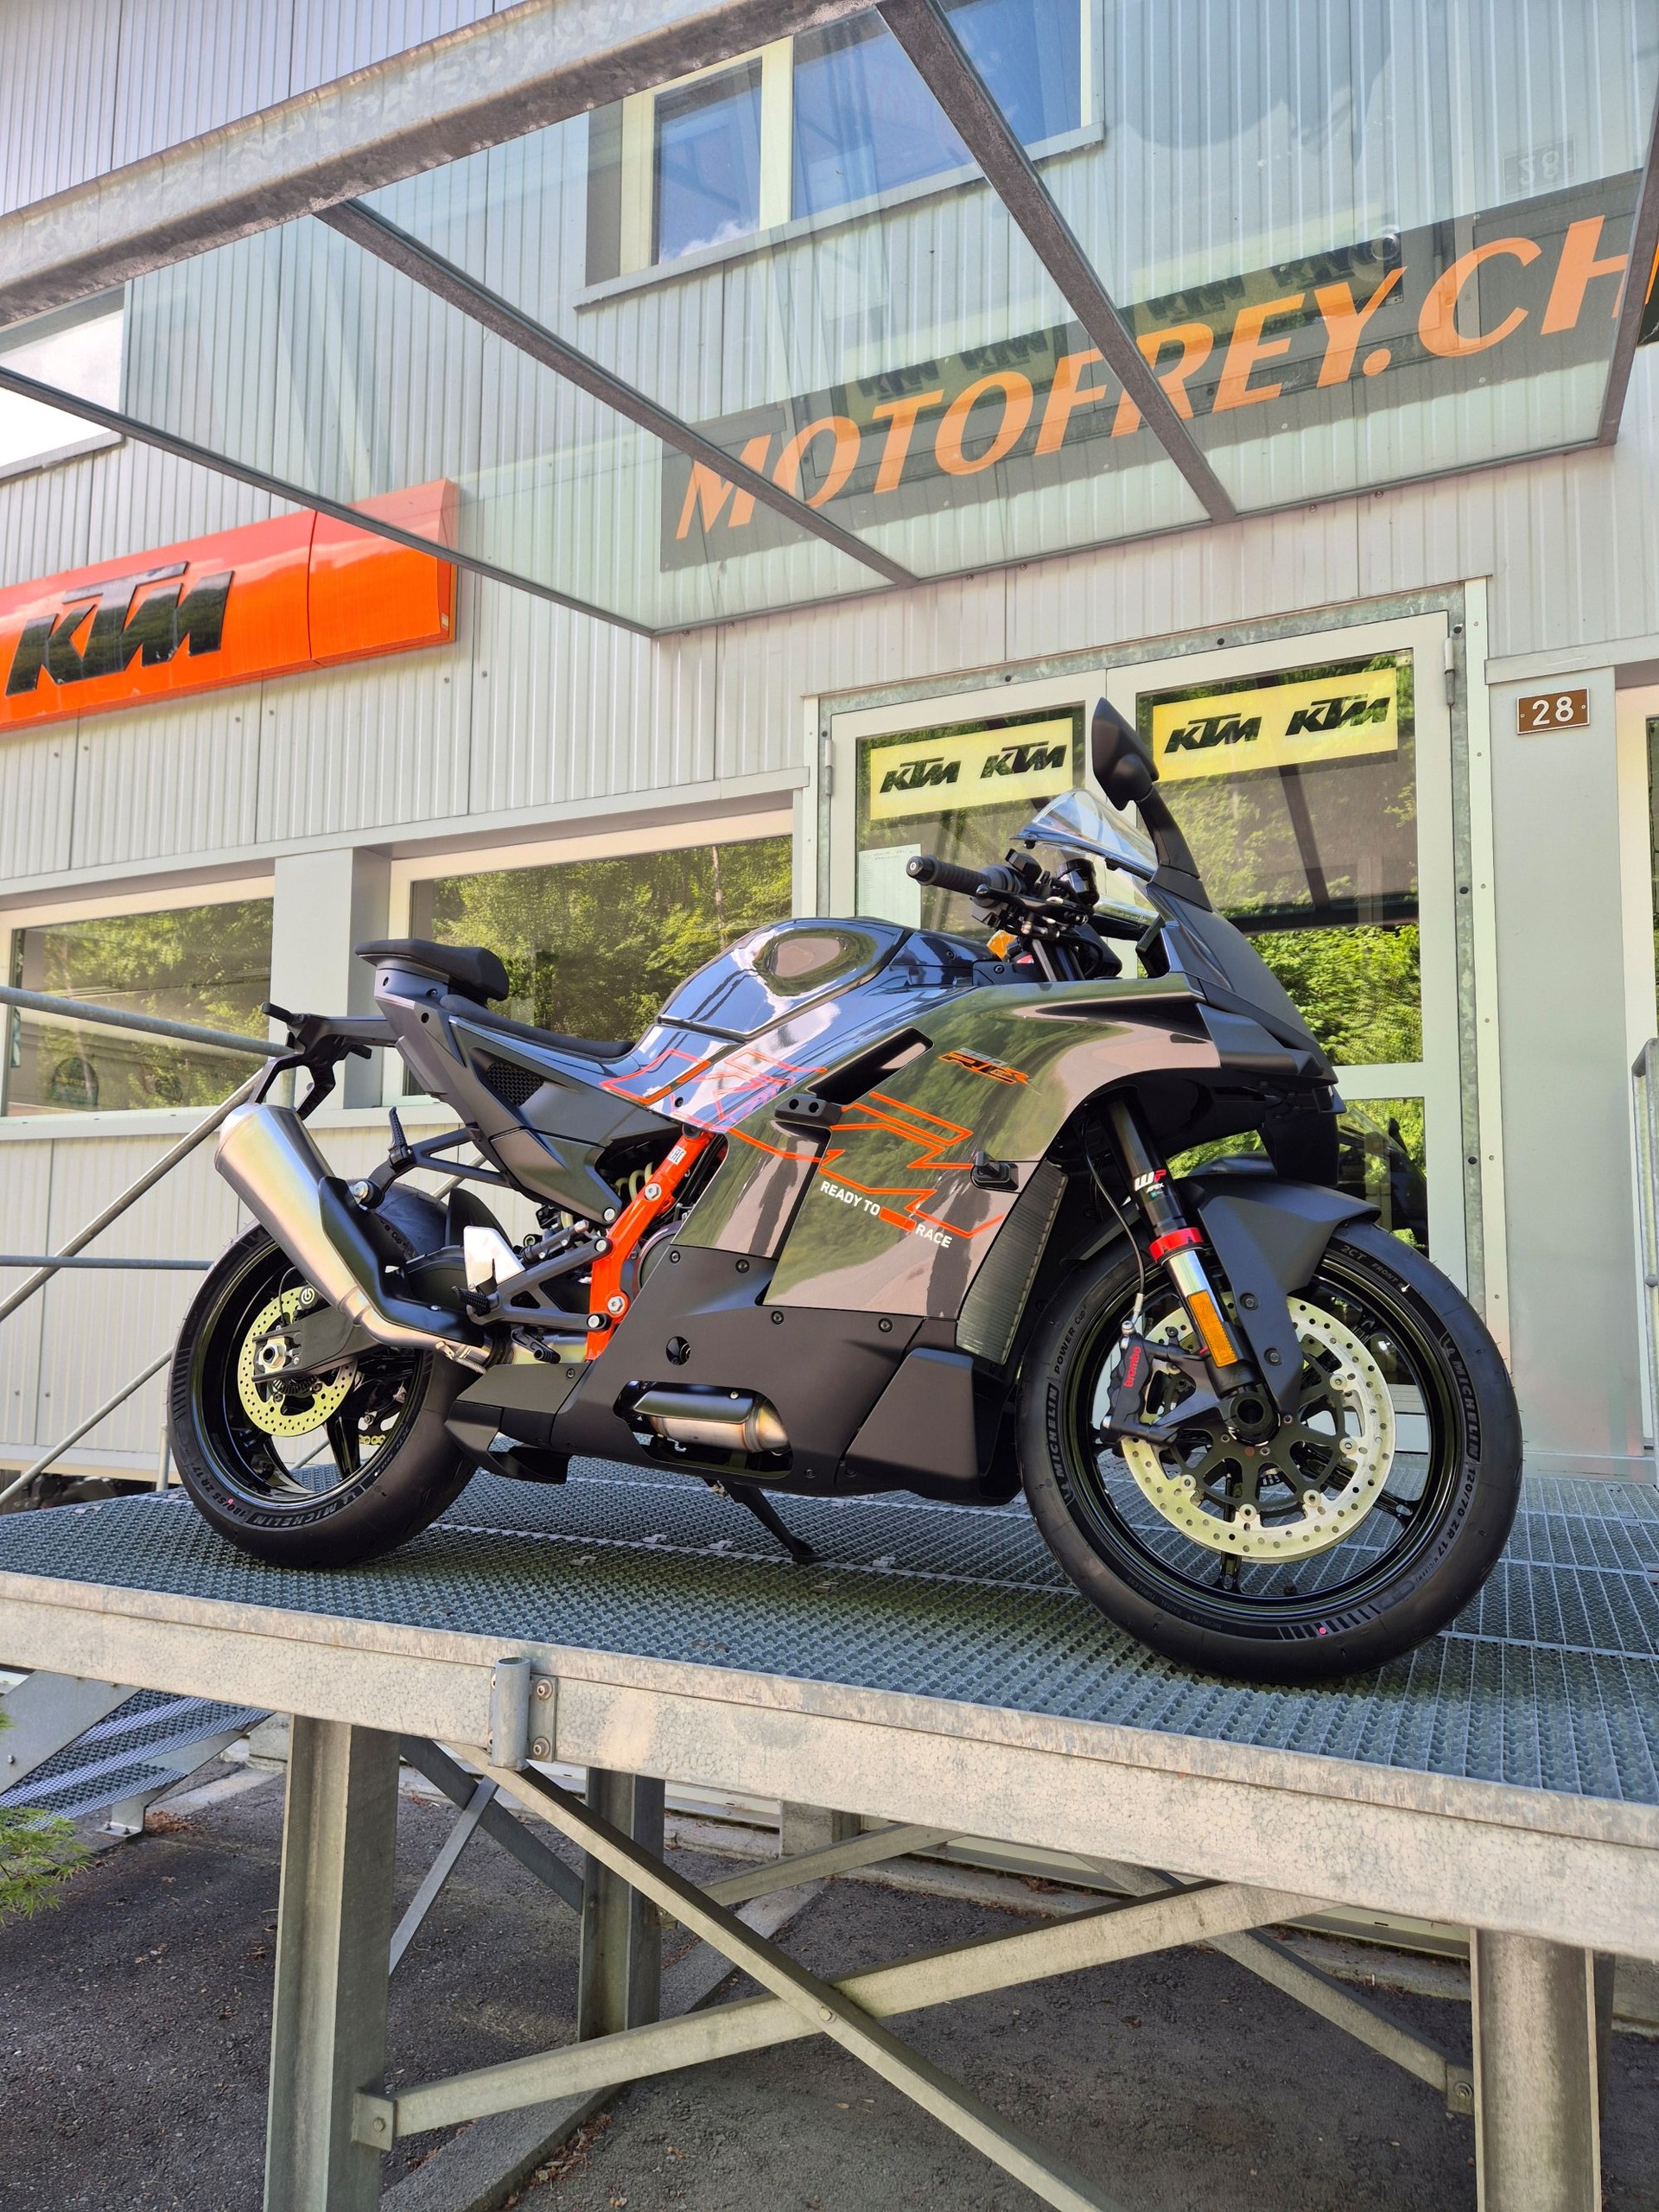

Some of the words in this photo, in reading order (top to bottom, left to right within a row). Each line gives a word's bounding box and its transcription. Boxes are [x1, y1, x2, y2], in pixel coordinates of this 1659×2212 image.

[6, 561, 235, 696] KTM
[1164, 713, 1262, 754] KTM
[1284, 695, 1391, 736] KTM
[1532, 696, 1574, 727] 28
[880, 757, 961, 793] KTM
[980, 741, 1066, 779] KTM
[820, 1180, 863, 1208] READY
[863, 1199, 880, 1217] TO
[915, 1223, 953, 1249] RACE
[1340, 1245, 1366, 1261] 2CT
[1371, 1262, 1398, 1282] FRONT
[1054, 1328, 1076, 1375] POWER
[1124, 1345, 1141, 1389] brembo
[1047, 1386, 1065, 1478] MICHELIN
[1452, 1360, 1479, 1459] MICHELIN
[200, 1478, 215, 1492] ZR
[1458, 1468, 1476, 1517] 120/70
[253, 1502, 338, 1527] MICHELIN
[1446, 1519, 1460, 1540] ZR
[1437, 1541, 1448, 1558] 17
